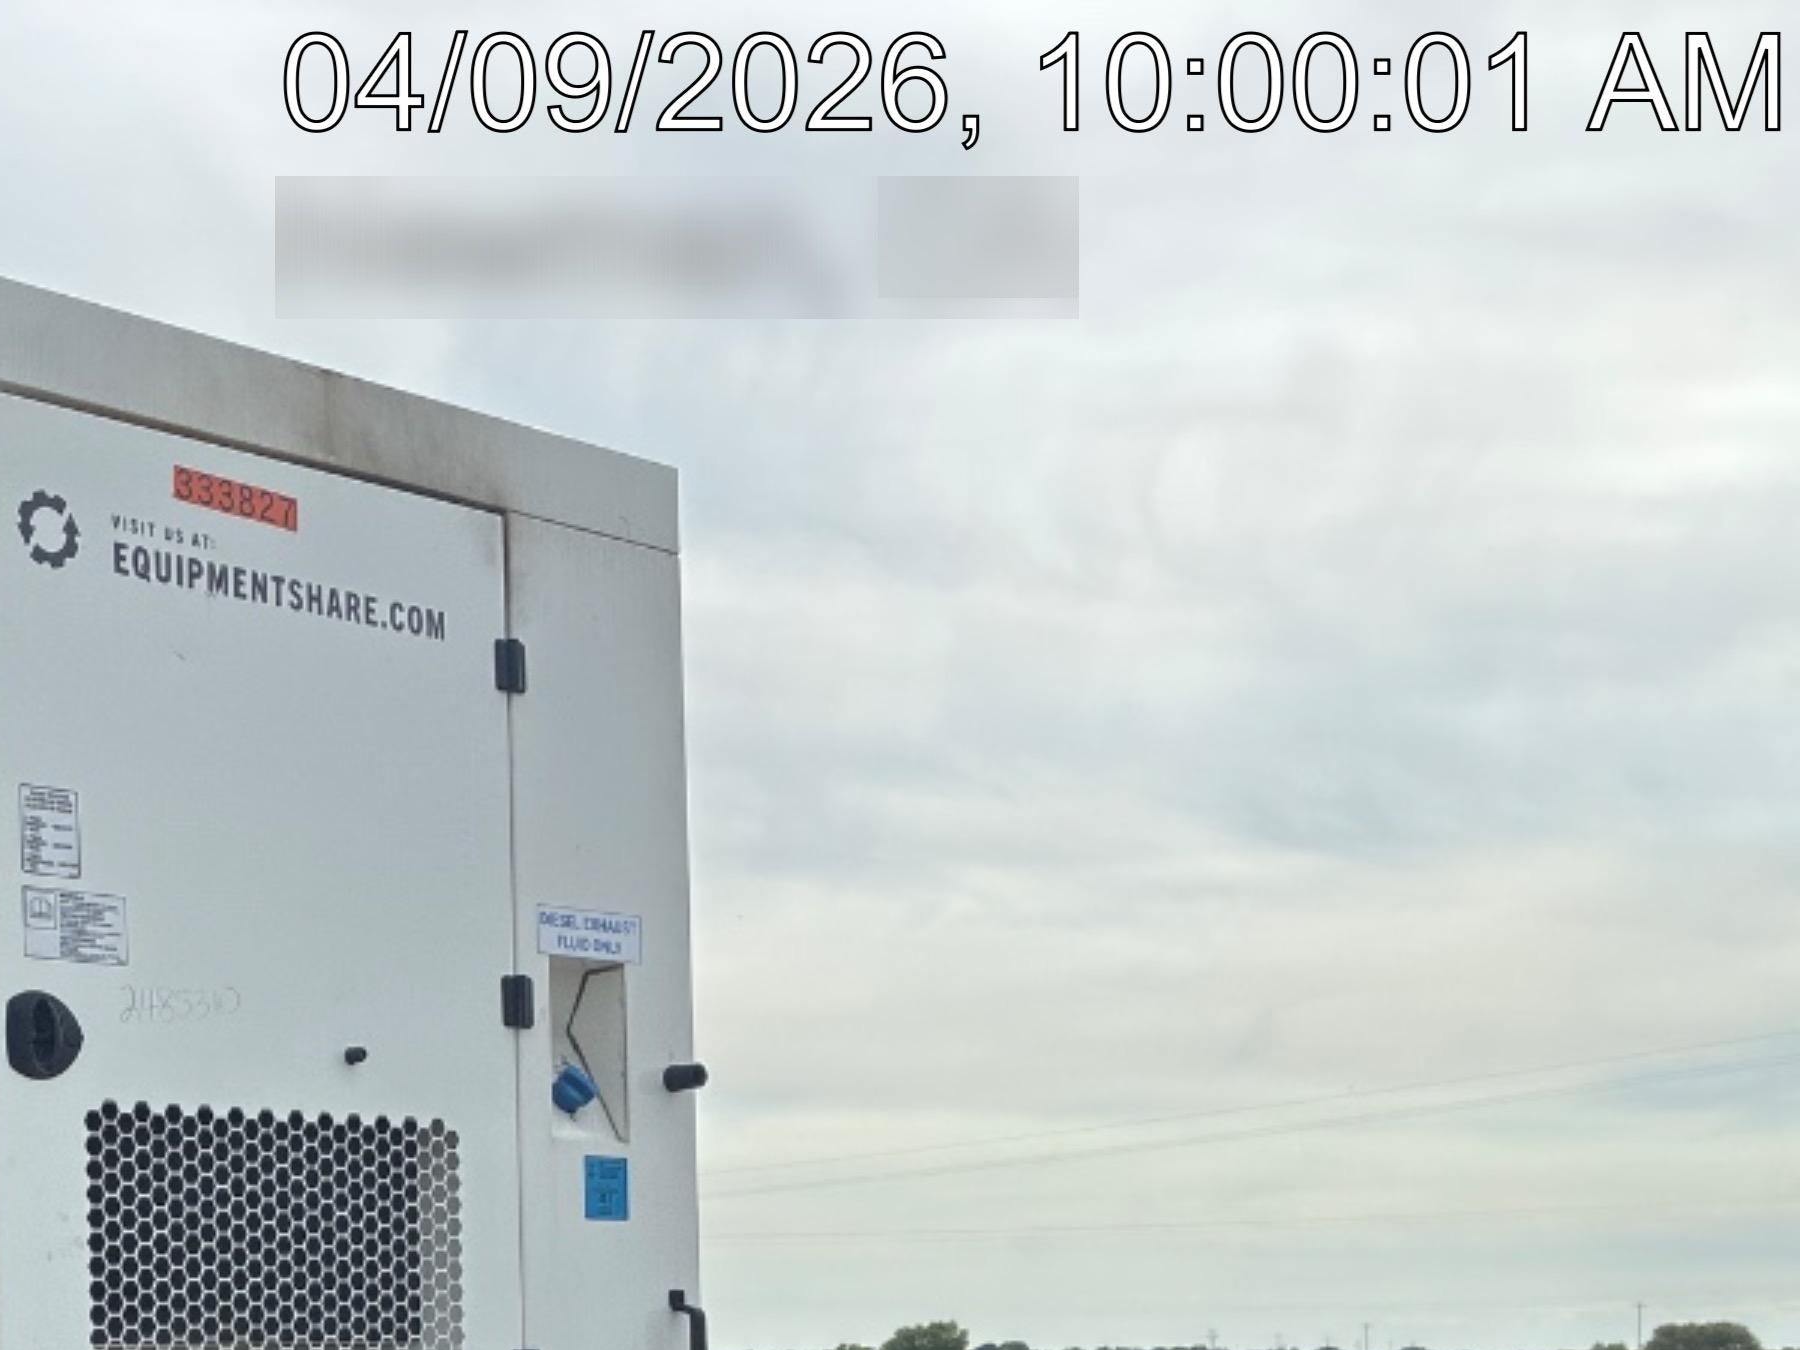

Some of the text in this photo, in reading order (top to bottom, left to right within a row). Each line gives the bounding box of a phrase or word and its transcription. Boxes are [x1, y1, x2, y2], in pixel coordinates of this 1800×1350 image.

[175, 467, 297, 529] 333827
[111, 514, 216, 550] VISIT US AT:
[112, 542, 446, 641] EQUIPMENTSHARE.COM
[539, 911, 637, 935] DIESEL EXHAUST
[558, 935, 622, 955] FLUID ONLY
